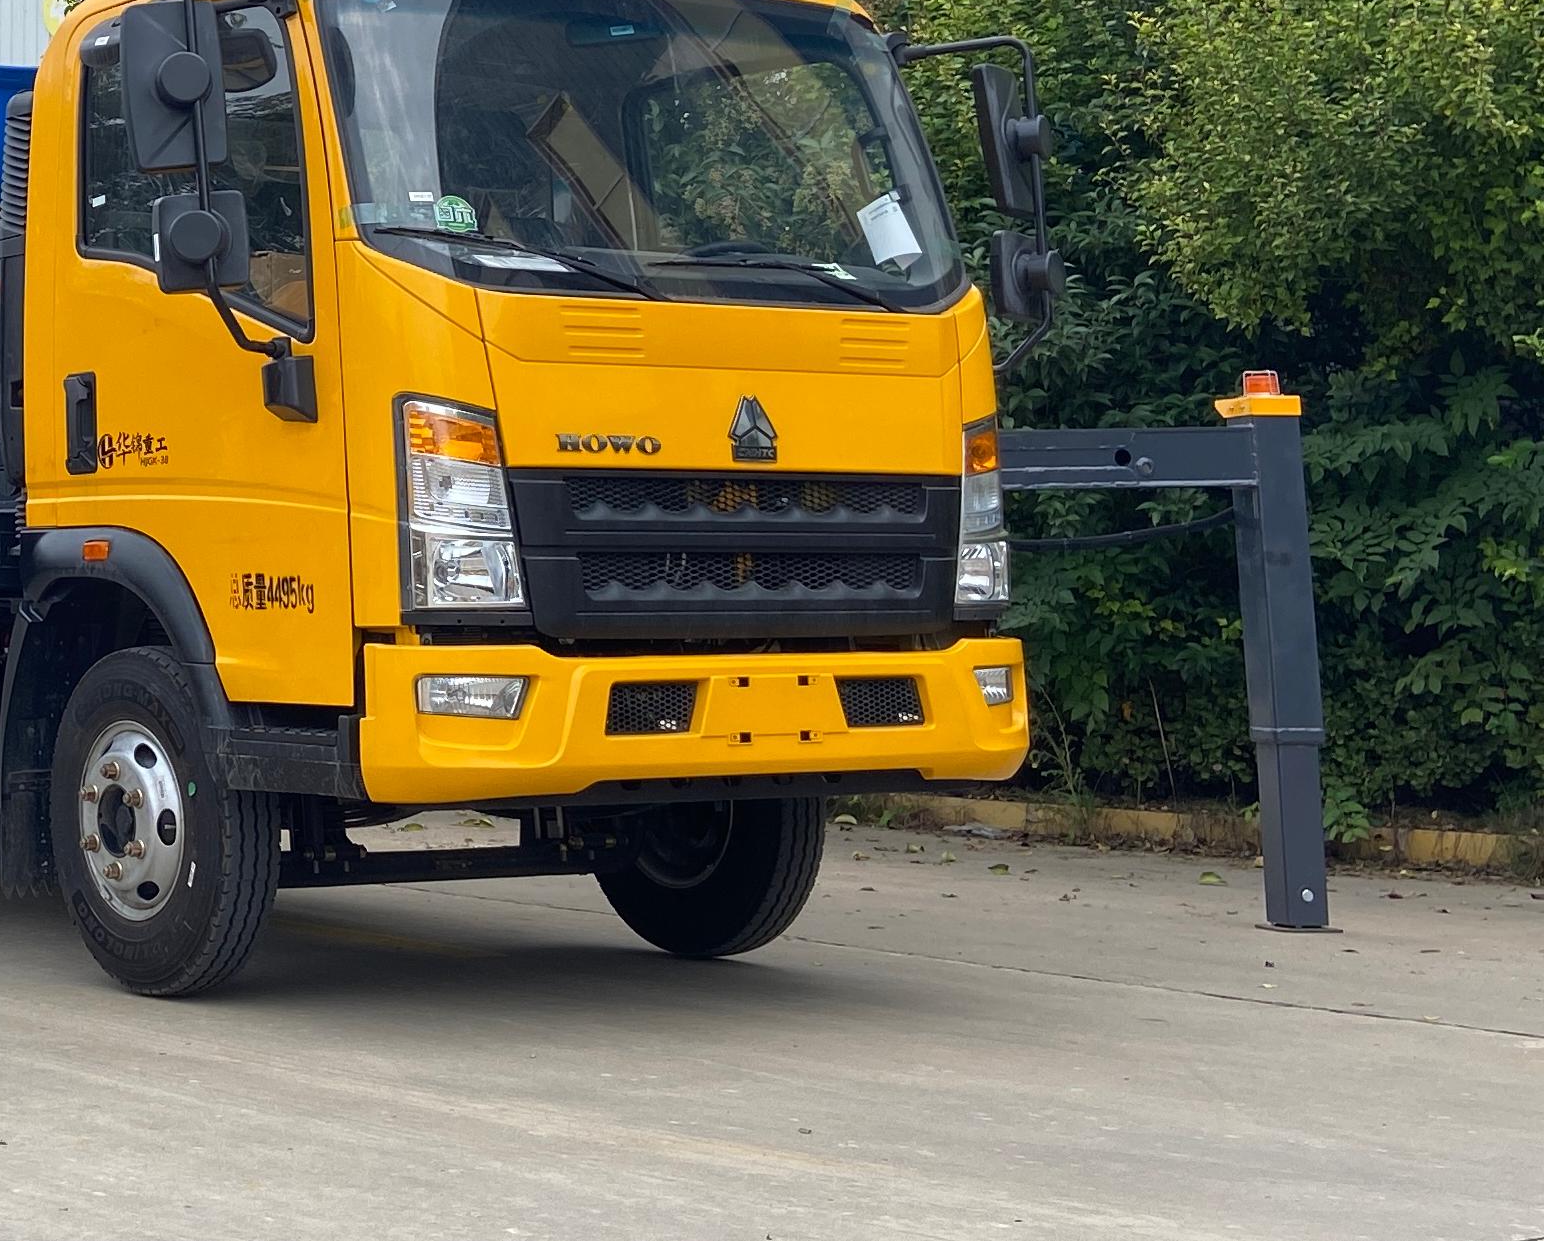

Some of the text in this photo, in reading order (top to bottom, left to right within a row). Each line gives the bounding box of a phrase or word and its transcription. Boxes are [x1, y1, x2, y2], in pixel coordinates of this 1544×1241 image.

[116, 432, 168, 466] 华锦重工
[555, 433, 662, 455] HOWO
[229, 573, 315, 614] 总质量4495kg
